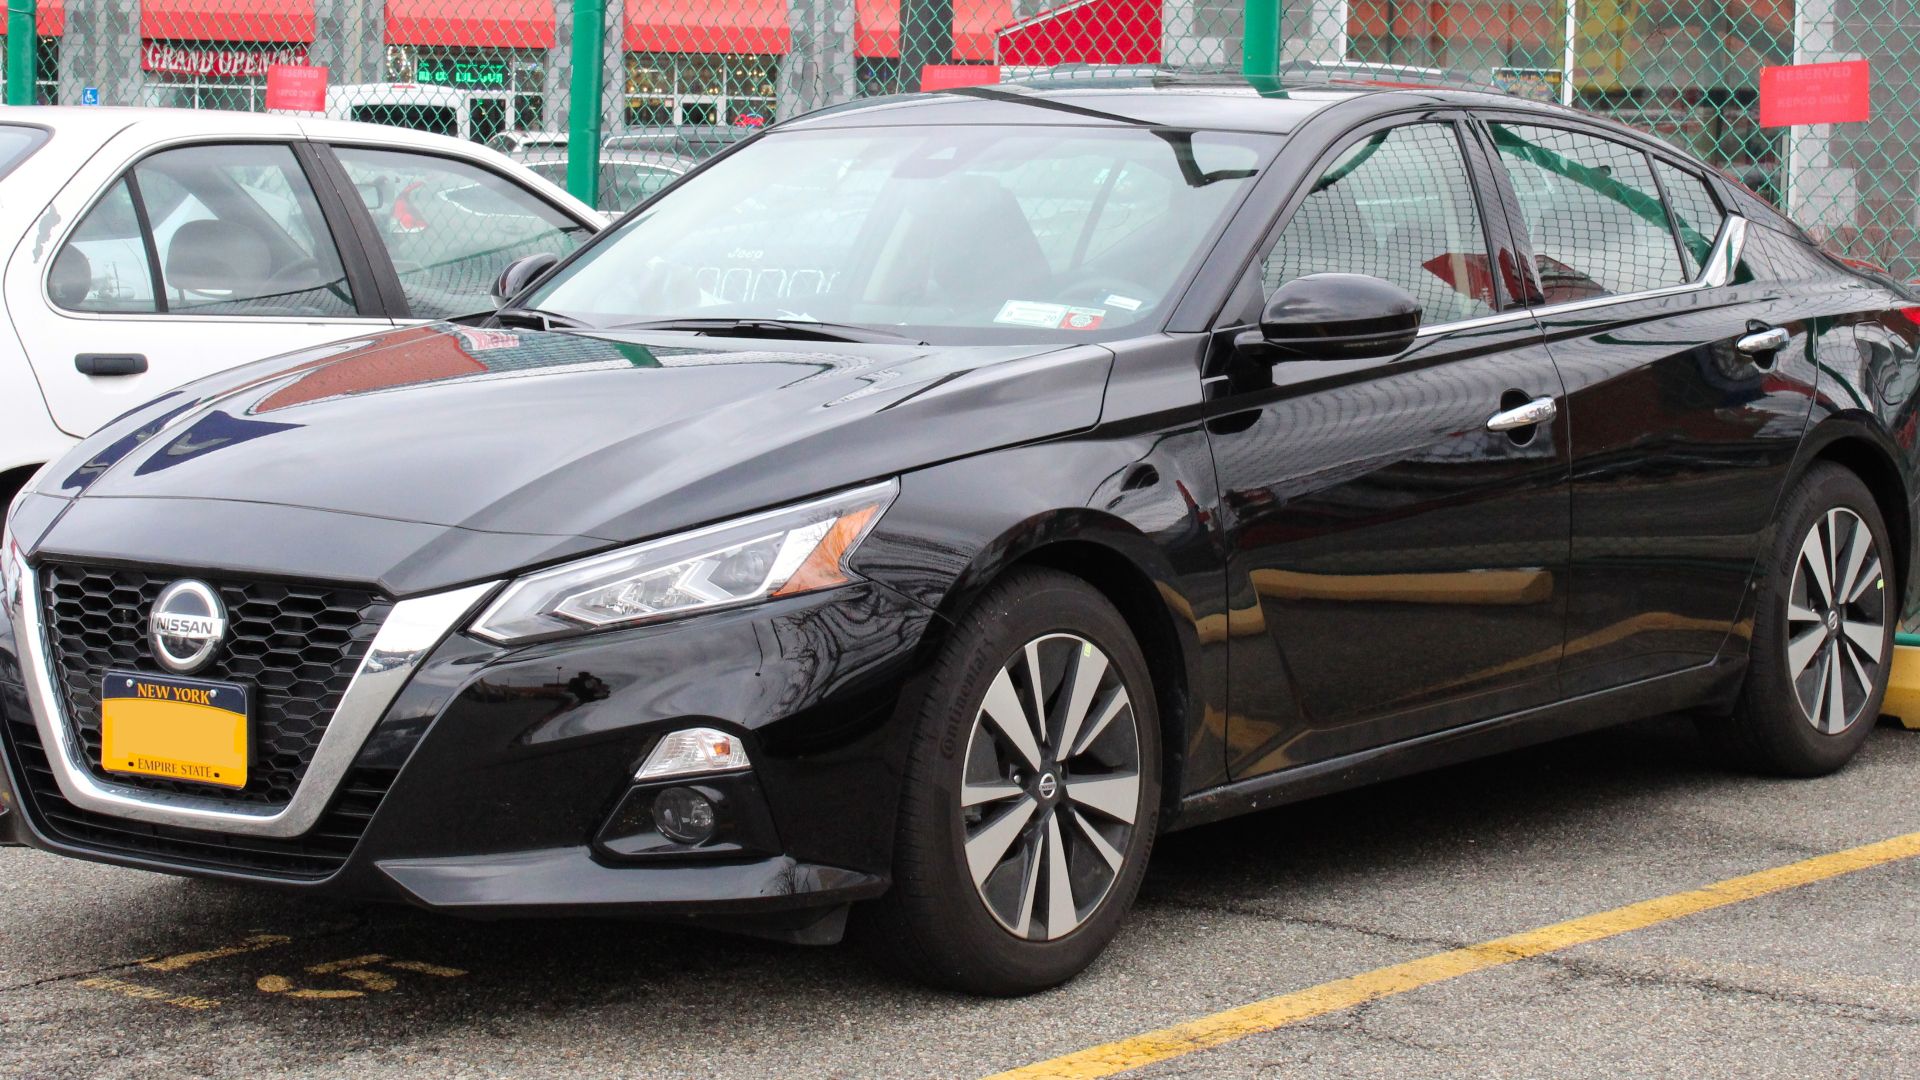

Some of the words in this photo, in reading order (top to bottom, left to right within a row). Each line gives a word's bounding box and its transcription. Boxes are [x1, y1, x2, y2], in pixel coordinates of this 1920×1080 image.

[147, 43, 214, 73] GRAND
[218, 47, 306, 75] OPENING
[276, 68, 319, 79] RESERVED
[933, 68, 988, 80] RESERVED
[1776, 65, 1852, 82] RESERVED
[1819, 92, 1851, 105] ONLY
[156, 616, 213, 635] NISSAN
[137, 683, 170, 700] NEW
[174, 687, 211, 705] YORK
[138, 758, 178, 774] EMPIRE
[181, 765, 213, 779] STATE
